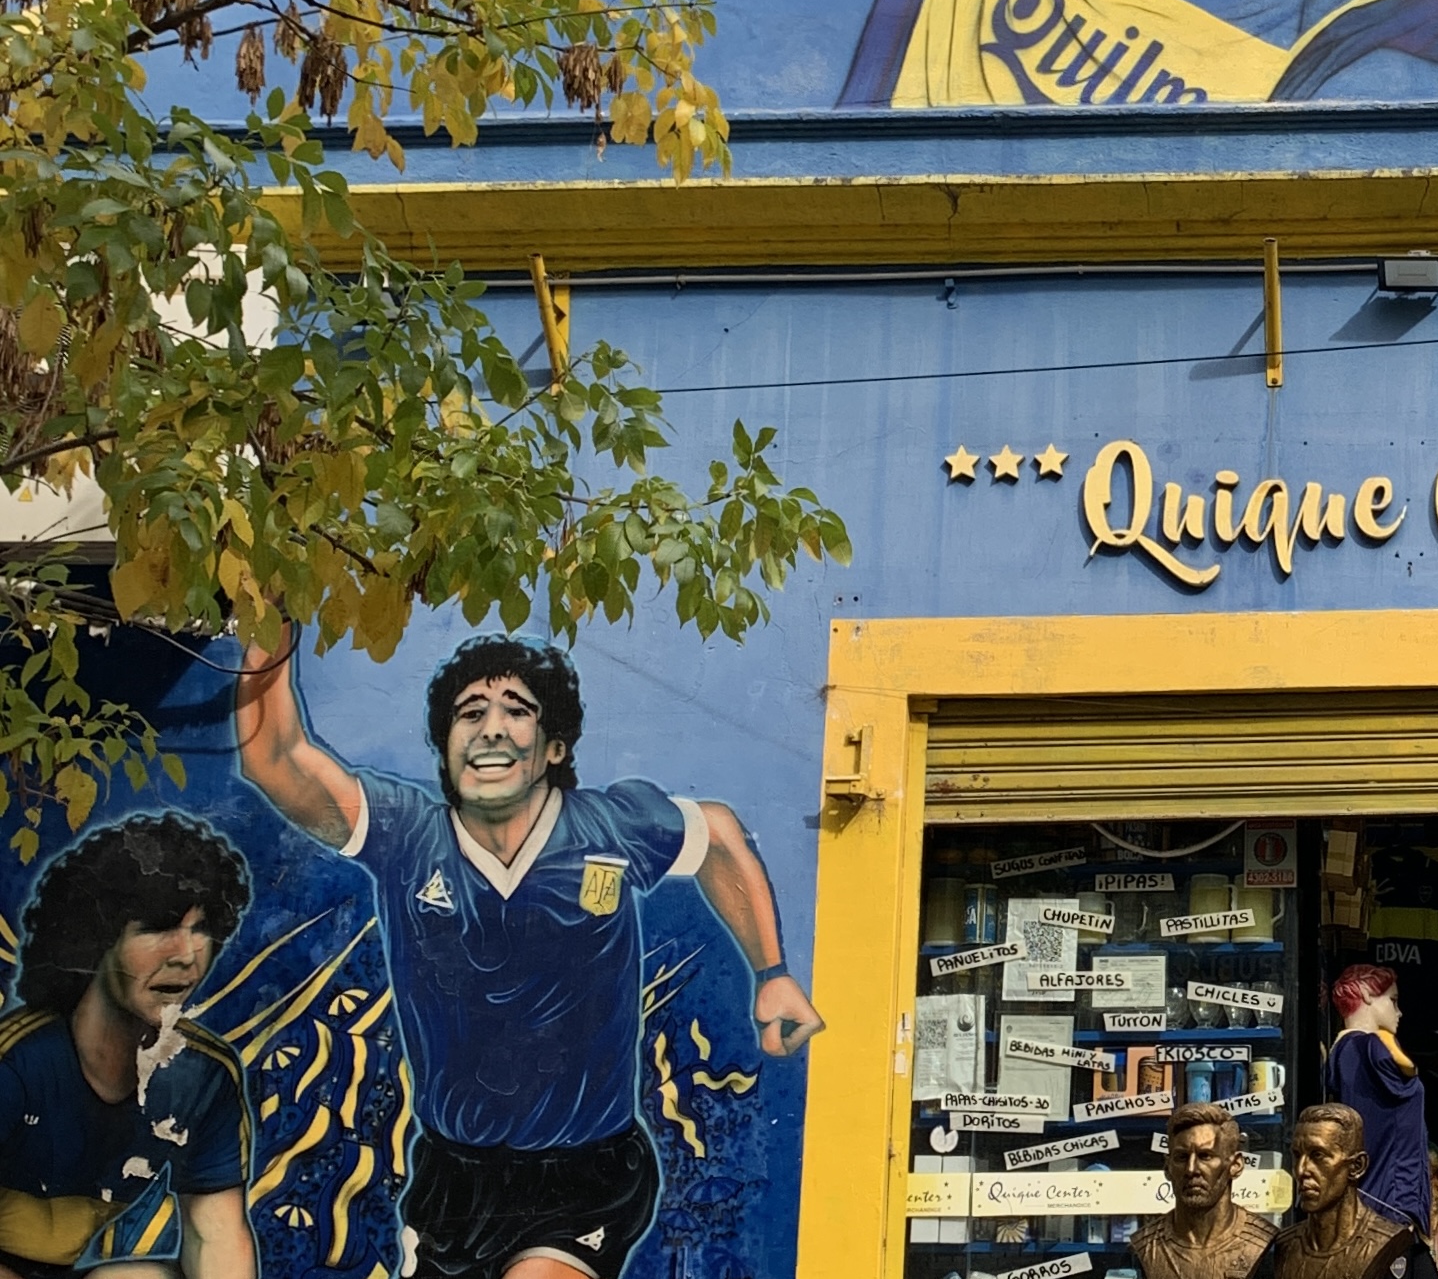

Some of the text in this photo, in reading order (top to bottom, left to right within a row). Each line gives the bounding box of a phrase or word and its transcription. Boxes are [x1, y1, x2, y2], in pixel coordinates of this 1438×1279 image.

[1084, 440, 1404, 587] Quique
[994, 859, 1034, 875] SUGUS
[1043, 908, 1112, 930] CHUPETIN
[1166, 912, 1249, 933] PASTILLITAS
[1040, 974, 1125, 987] ALFAJORES
[1194, 985, 1260, 1006] CHICLES
[1009, 1040, 1055, 1057] BEBIDAS
[1085, 1096, 1156, 1117] PANCHOS
[963, 1114, 1020, 1129] DORITOS
[1008, 1136, 1108, 1166] BEBIDAS CHICAS
[906, 1191, 943, 1202] enter
[988, 1181, 1093, 1204] Quique Center
